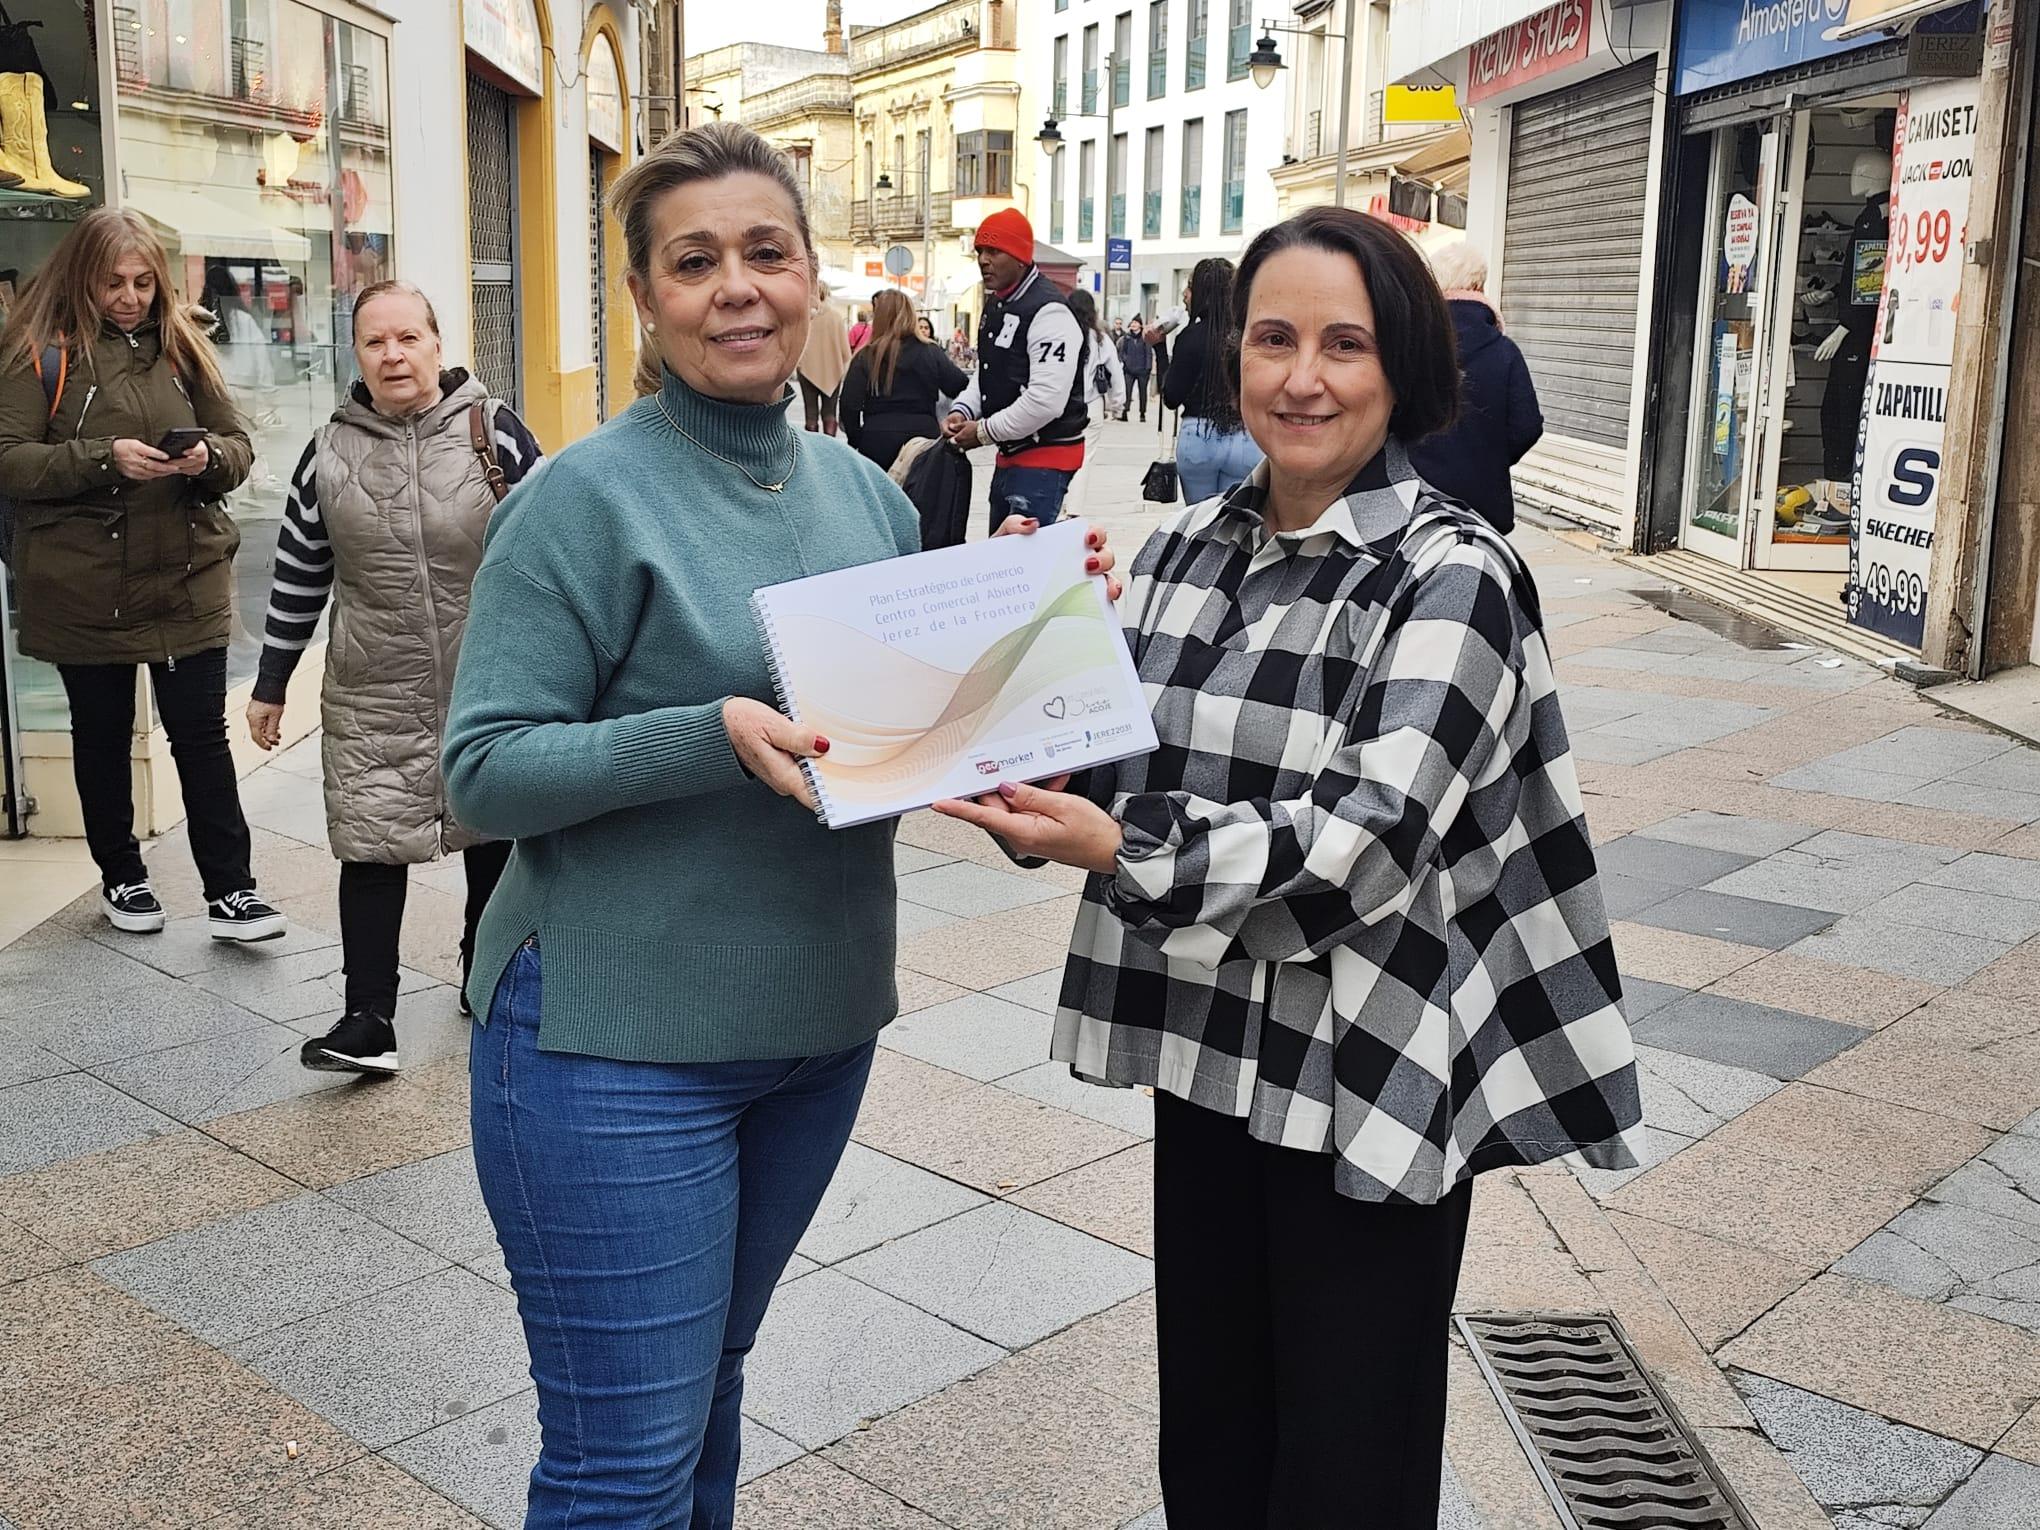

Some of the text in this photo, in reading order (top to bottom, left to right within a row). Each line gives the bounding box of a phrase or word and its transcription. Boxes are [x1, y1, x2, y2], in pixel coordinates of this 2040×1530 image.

[1470, 0, 1583, 88] TRENDY SHOES
[1920, 36, 1971, 51] JEREZ
[1902, 162, 1929, 184] JACK
[1896, 209, 1951, 273] 9,99
[1038, 341, 1067, 363] 74
[1855, 450, 1864, 468] €
[1850, 471, 1862, 533] 49,99
[1850, 538, 1859, 554] €
[869, 565, 1024, 606] Plan Estratégico de Comercio
[875, 582, 1031, 625] Centro Comercial Abierto
[1849, 559, 1861, 619] 49,99
[1866, 561, 1923, 617] 49,99
[882, 600, 1037, 644] Jerez de la Frontera
